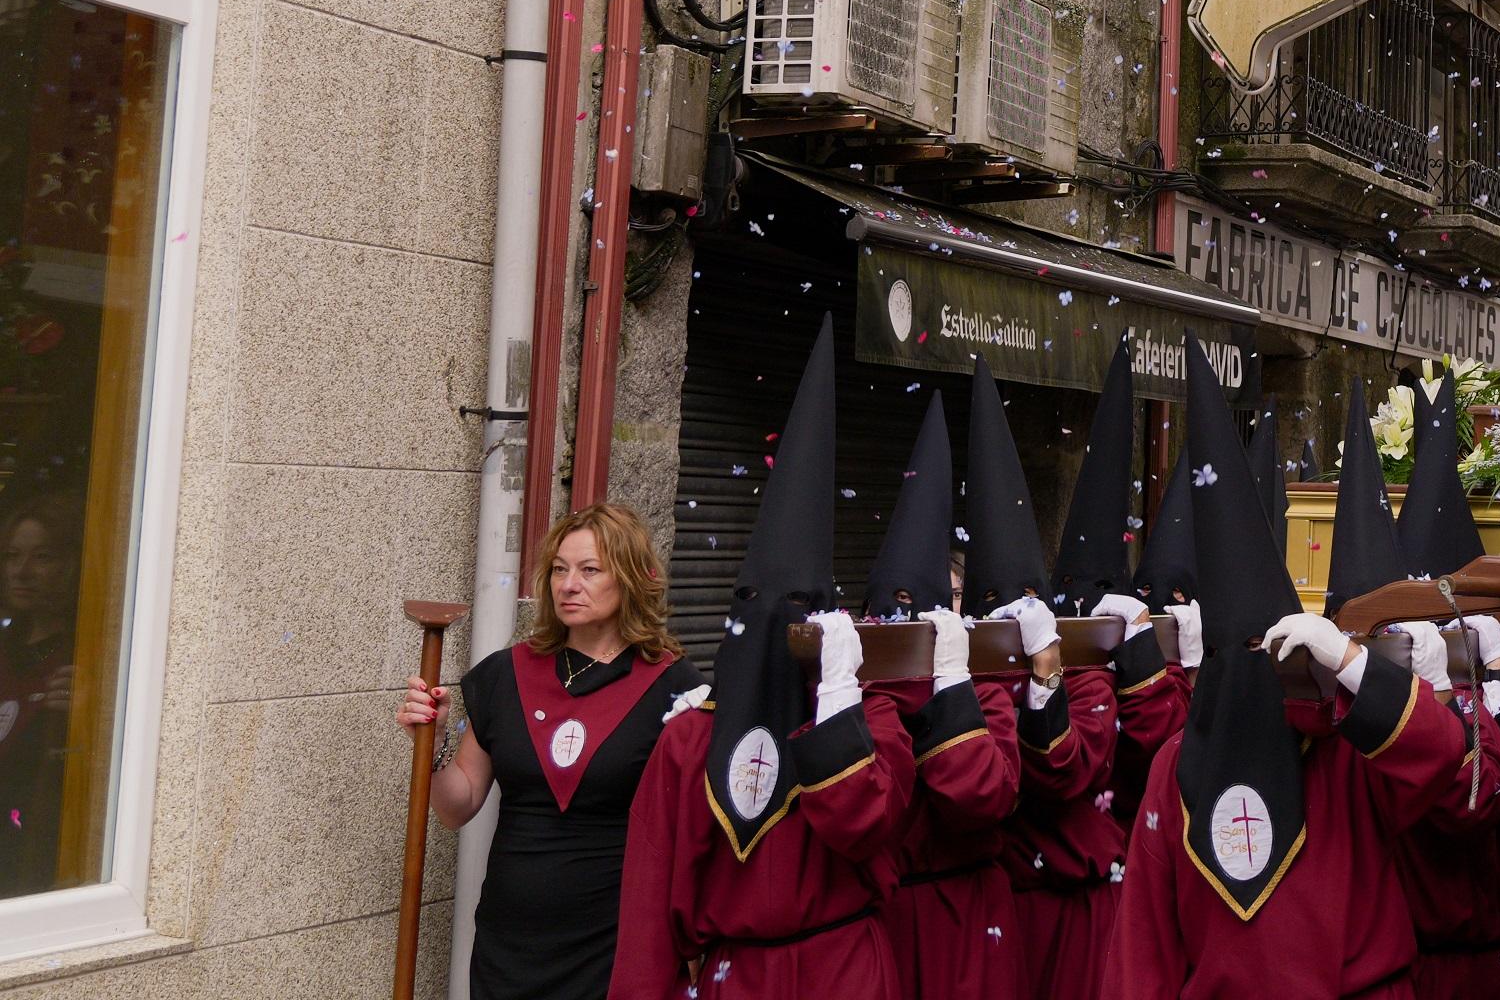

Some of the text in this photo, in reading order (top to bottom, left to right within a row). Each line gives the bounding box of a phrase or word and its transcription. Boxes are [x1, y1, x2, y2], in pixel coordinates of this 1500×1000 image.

[940, 303, 993, 343] Estrella
[1186, 209, 1312, 321] FABRICA
[1331, 257, 1360, 332] DE
[1375, 271, 1496, 364] CHOCOLATES
